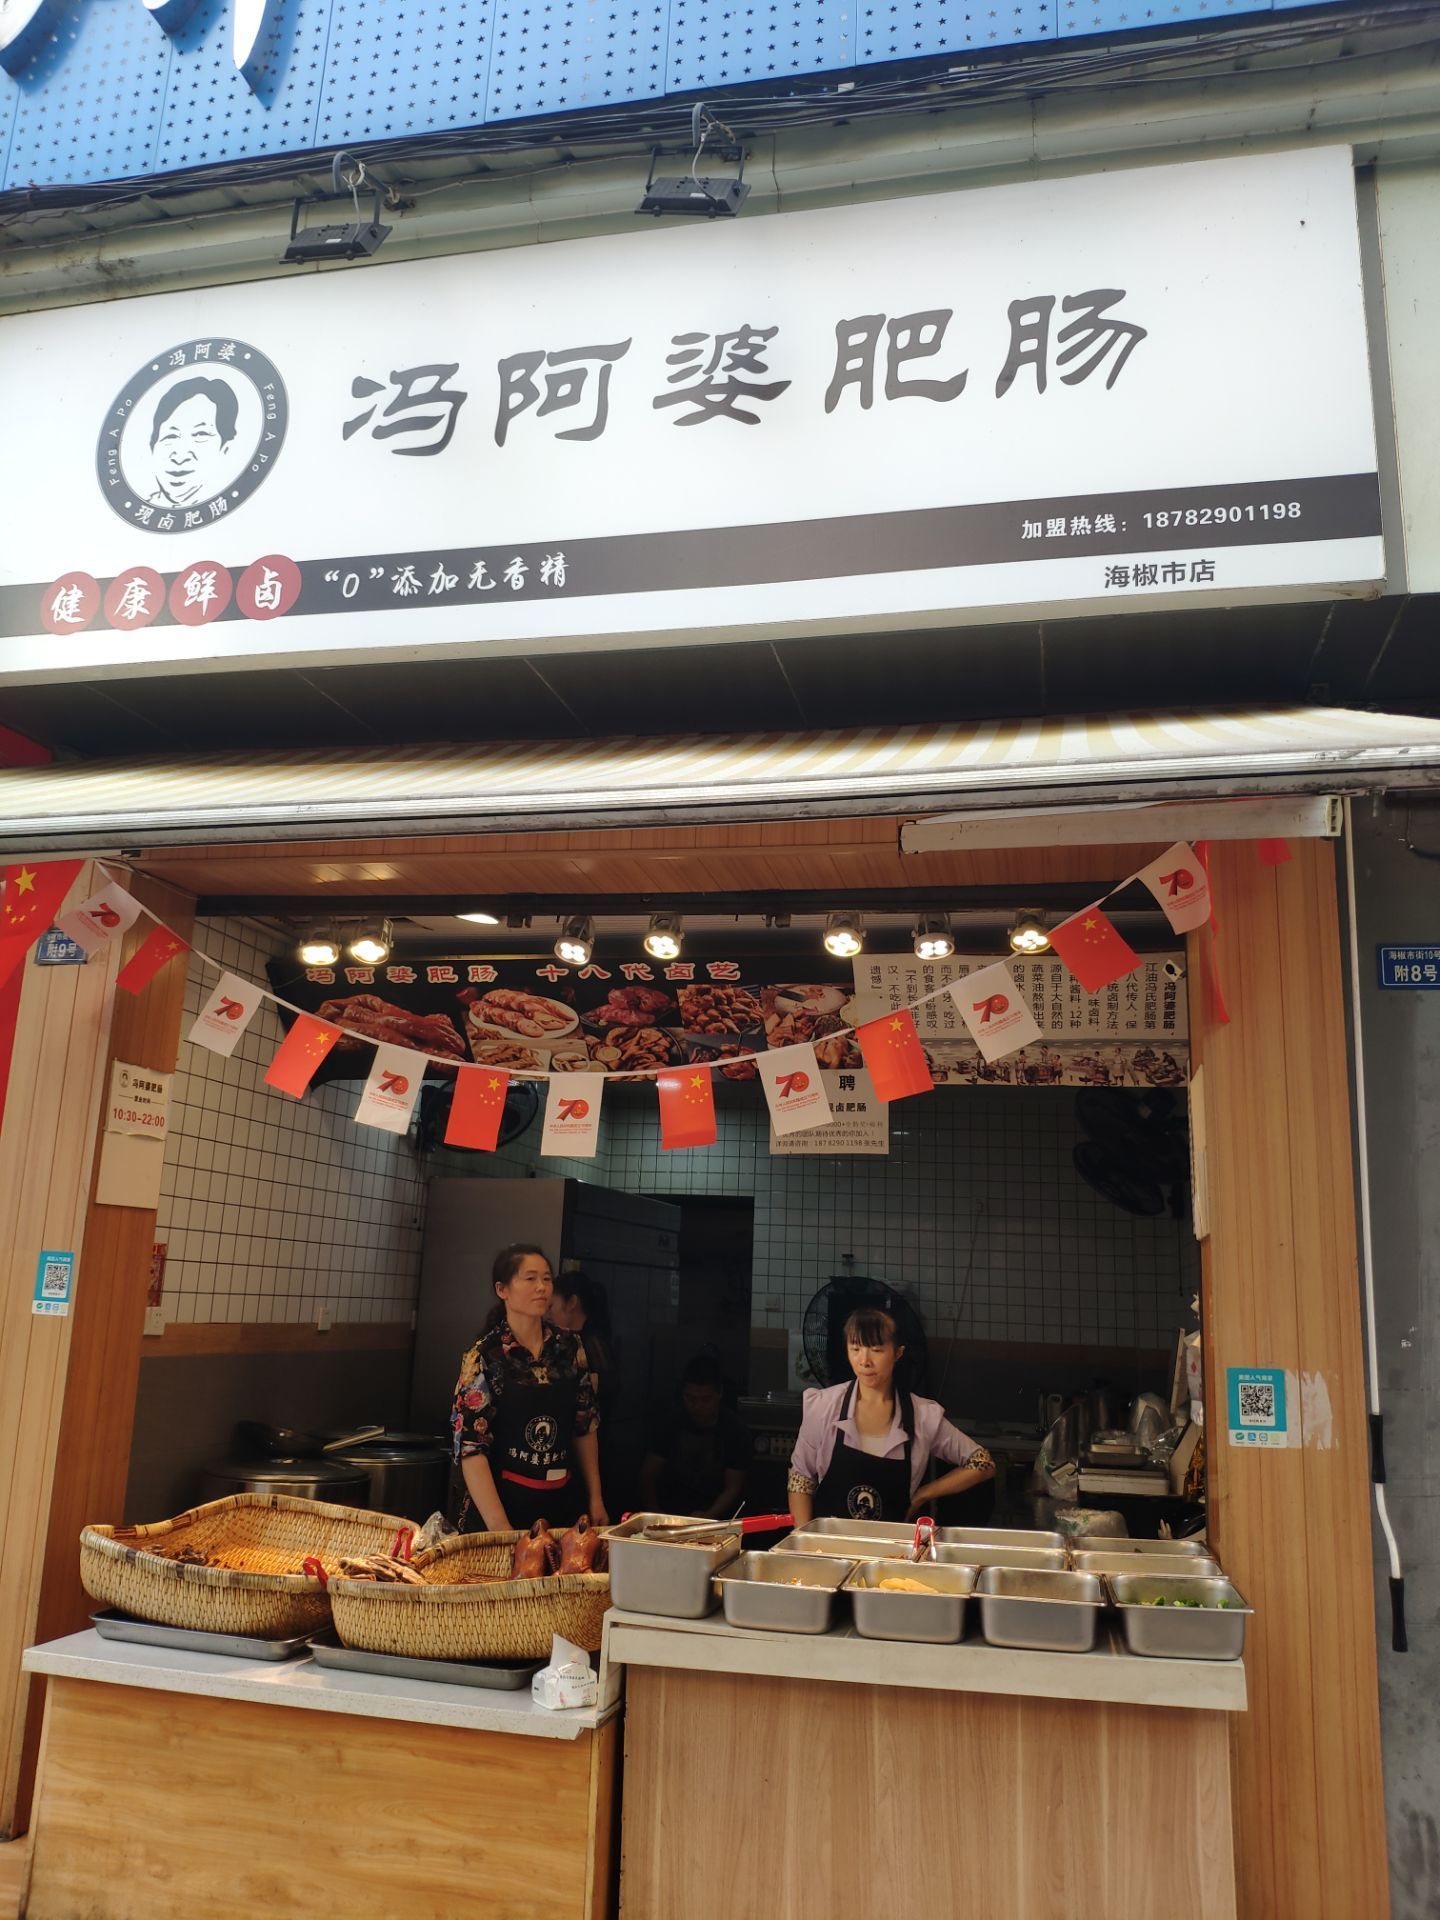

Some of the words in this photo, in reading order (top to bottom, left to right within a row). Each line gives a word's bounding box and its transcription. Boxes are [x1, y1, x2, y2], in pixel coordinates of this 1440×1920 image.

[169, 342, 237, 366] 冯阿婆
[343, 288, 1147, 457] 冯阿婆肥肠
[116, 399, 133, 417] Po
[263, 382, 277, 421] Feng
[109, 428, 120, 438] A
[264, 431, 277, 441] A
[107, 448, 120, 487] Feng
[251, 452, 269, 473] Po
[134, 496, 228, 530] 现卤肥肠
[1104, 557, 1217, 590] 海椒市店
[50, 568, 282, 624] 健康鲜卤
[305, 964, 499, 985] 冯阿婆肥肠
[536, 960, 741, 983] 十八代卤艺
[1394, 964, 1438, 982] 附8号
[1050, 964, 1063, 1030] 源自于大自然的
[113, 1108, 165, 1127] 10:30-22:00
